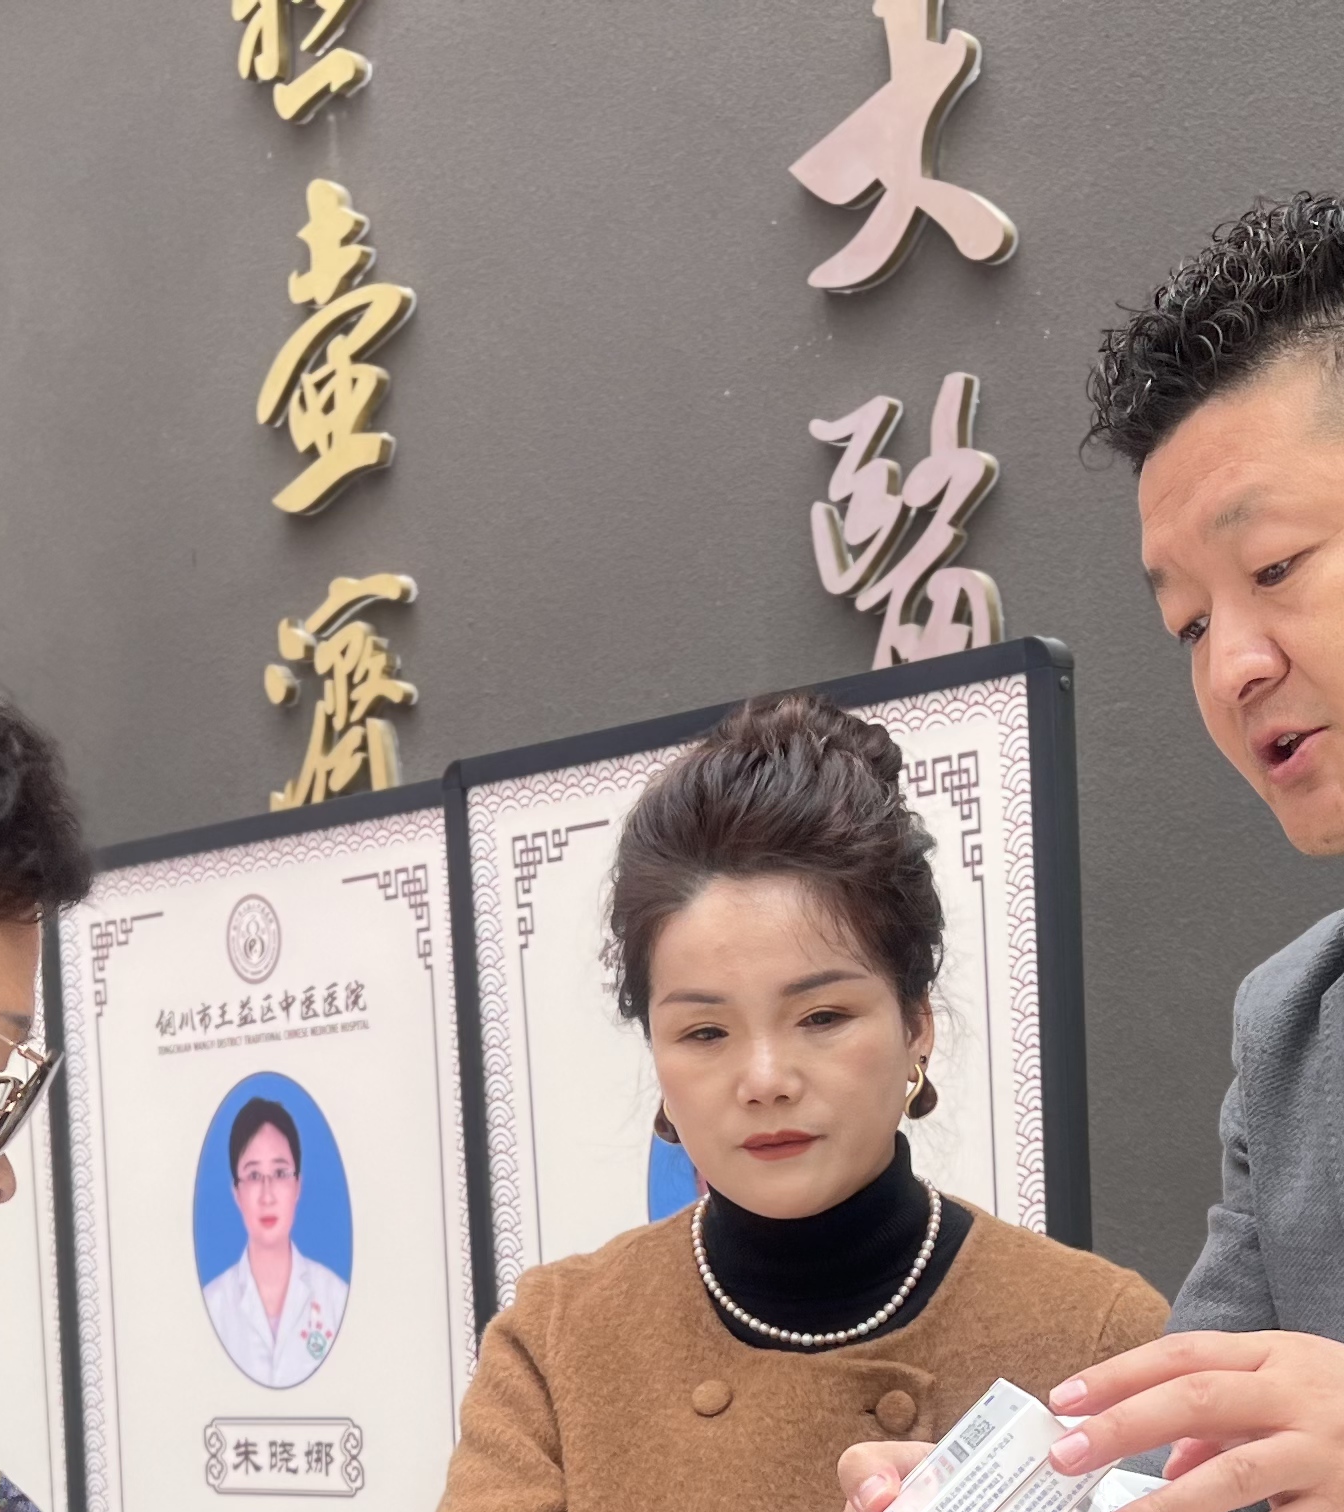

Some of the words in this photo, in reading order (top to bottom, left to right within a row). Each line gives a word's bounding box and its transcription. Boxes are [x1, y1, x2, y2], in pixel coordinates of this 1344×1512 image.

[156, 980, 368, 1037] 铜川市王益区中医医院
[231, 1437, 336, 1477] 朱晓娜
